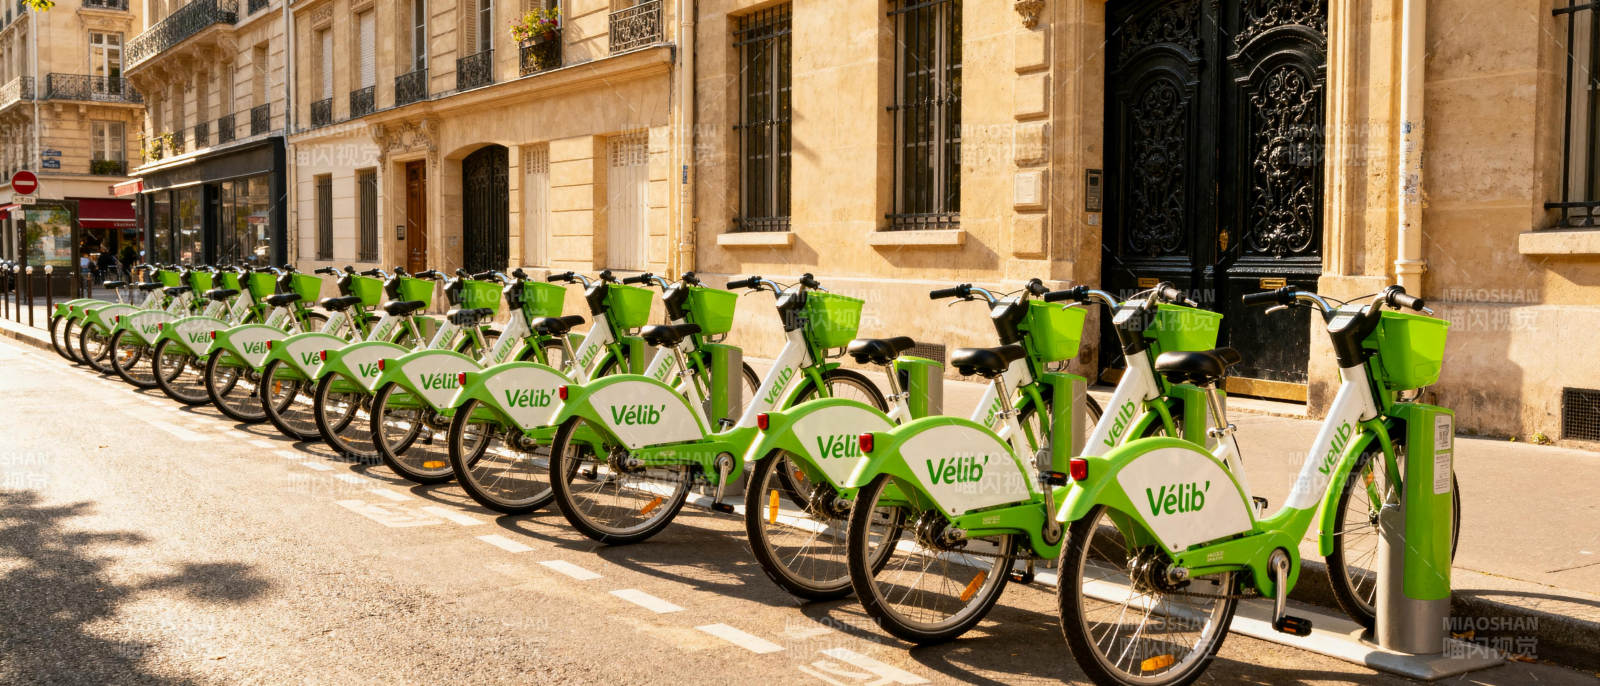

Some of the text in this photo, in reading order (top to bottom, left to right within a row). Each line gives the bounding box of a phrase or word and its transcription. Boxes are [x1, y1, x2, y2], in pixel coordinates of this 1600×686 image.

[505, 388, 555, 408] Vélib'
[611, 405, 665, 425] Vélib'
[926, 455, 989, 485] Vélib'
[1146, 481, 1210, 516] Vélib'
